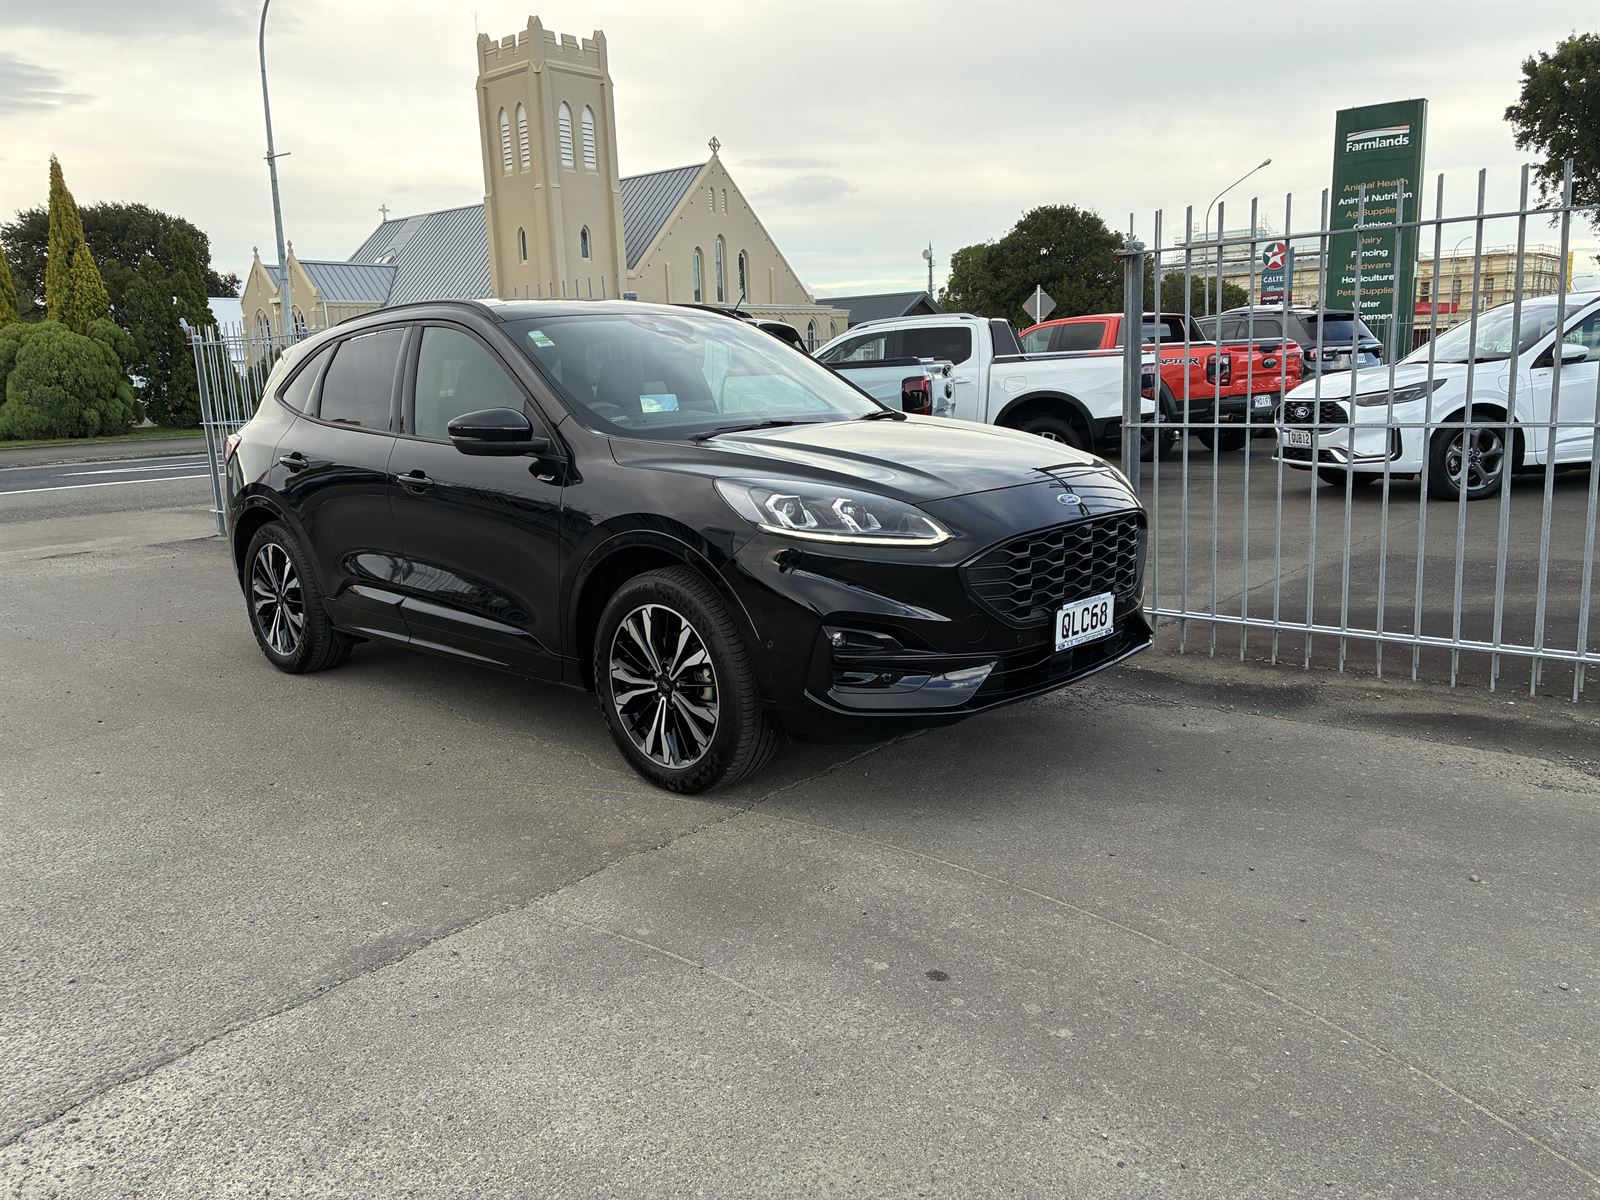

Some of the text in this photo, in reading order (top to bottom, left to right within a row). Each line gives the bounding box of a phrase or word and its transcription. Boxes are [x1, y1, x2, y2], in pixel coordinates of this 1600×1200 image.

[1345, 134, 1410, 153] Farmlands
[1377, 178, 1409, 187] Healh
[1371, 191, 1413, 202] Nutriton
[1345, 210, 1360, 219] Ag
[1361, 236, 1383, 245] airy
[1350, 248, 1389, 258] Fncing
[1344, 262, 1392, 271] Hadware
[1263, 275, 1285, 283] CALTE
[1341, 274, 1395, 284] Horiculture
[1359, 286, 1394, 296] Supplie
[1061, 601, 1108, 640] QLC68
